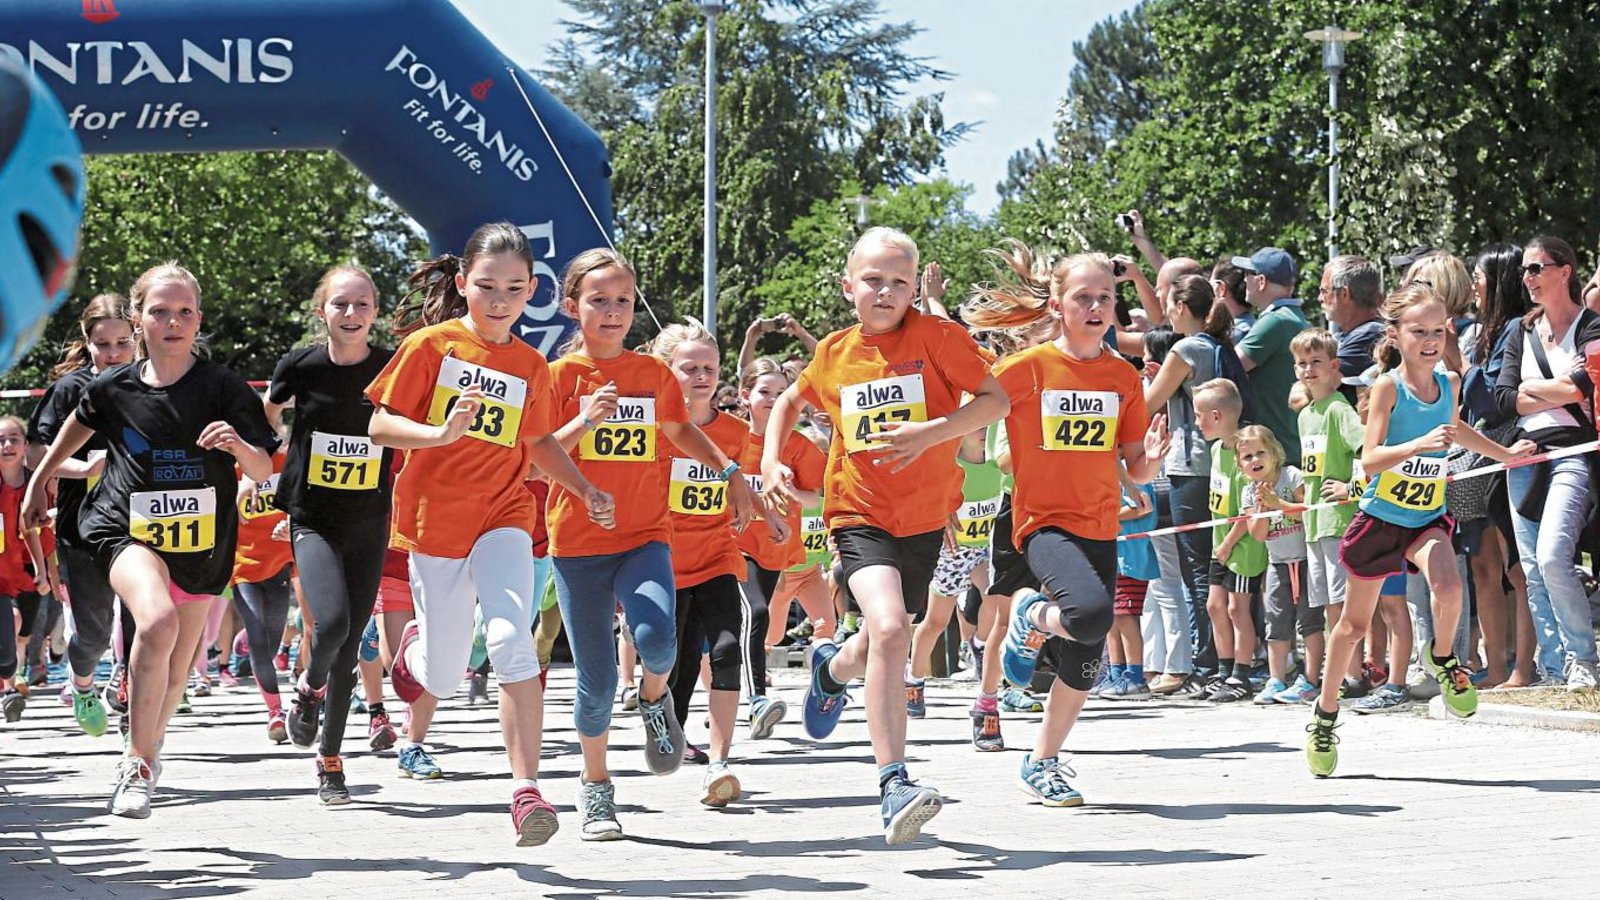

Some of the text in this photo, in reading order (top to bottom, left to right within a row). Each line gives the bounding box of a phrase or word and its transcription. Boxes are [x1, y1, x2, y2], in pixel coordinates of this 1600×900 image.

[0, 38, 293, 85] NTANIS
[68, 103, 209, 130] for life.
[384, 44, 539, 181] FONTANIS
[403, 99, 483, 175] Fit for life.
[458, 368, 508, 398] alwa
[856, 383, 904, 407] alwa
[1059, 392, 1104, 412] alwa
[594, 427, 647, 457] 623
[1055, 419, 1106, 446] 422
[152, 449, 187, 460] FSR
[327, 437, 369, 455] alwa
[320, 459, 367, 486] 571
[687, 464, 721, 479] alw
[1402, 458, 1441, 477] alwa
[150, 493, 199, 514] alwa
[681, 485, 724, 511] 634
[1390, 480, 1436, 506] 429
[969, 502, 996, 517] alwa
[146, 520, 200, 548] 311
[966, 517, 995, 539] 44
